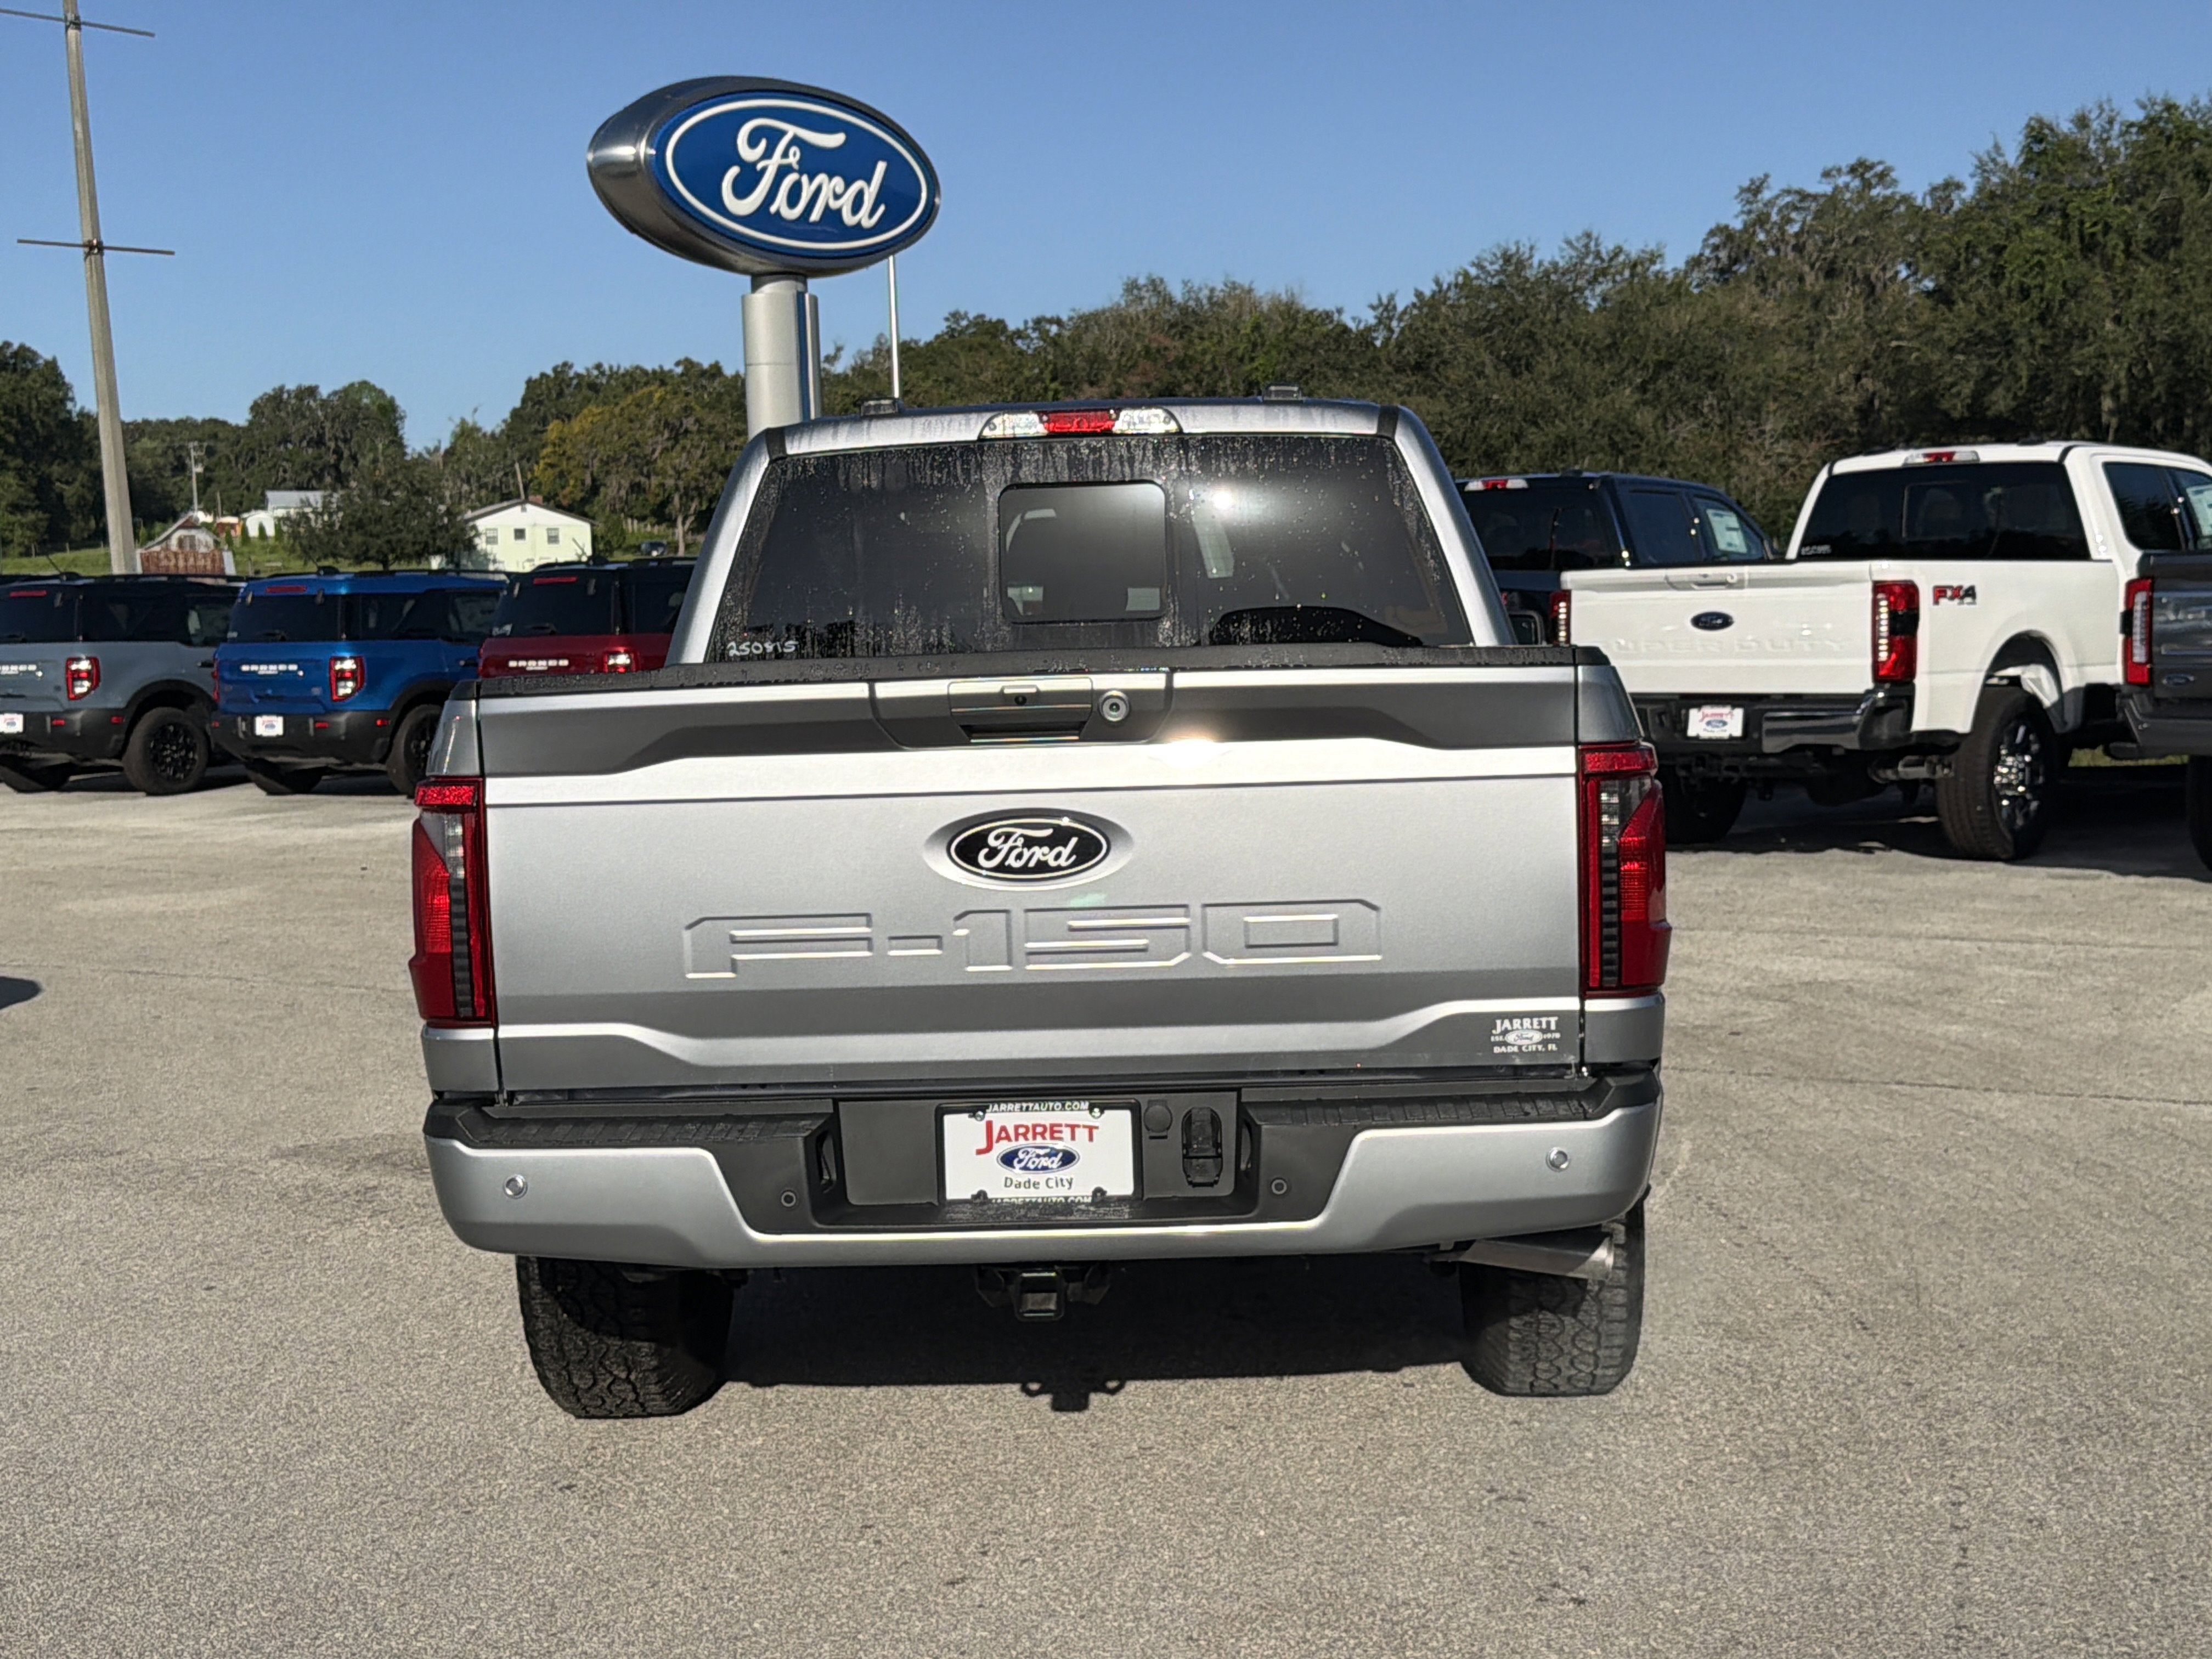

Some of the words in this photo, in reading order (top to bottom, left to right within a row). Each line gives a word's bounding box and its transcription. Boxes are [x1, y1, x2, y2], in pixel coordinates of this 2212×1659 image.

[721, 117, 887, 229] Ford
[1932, 585, 1977, 606] FX4
[978, 827, 1079, 868] Ford
[684, 899, 1383, 979] F-150
[1492, 1016, 1559, 1034] JARRETT
[1493, 1045, 1519, 1053] DADE
[986, 1102, 1089, 1112] JARRETTAUTO.COM
[975, 1120, 1099, 1155] JARRETT
[1013, 1148, 1063, 1170] Ford
[1004, 1176, 1040, 1189] Dade
[1045, 1177, 1074, 1190] City
